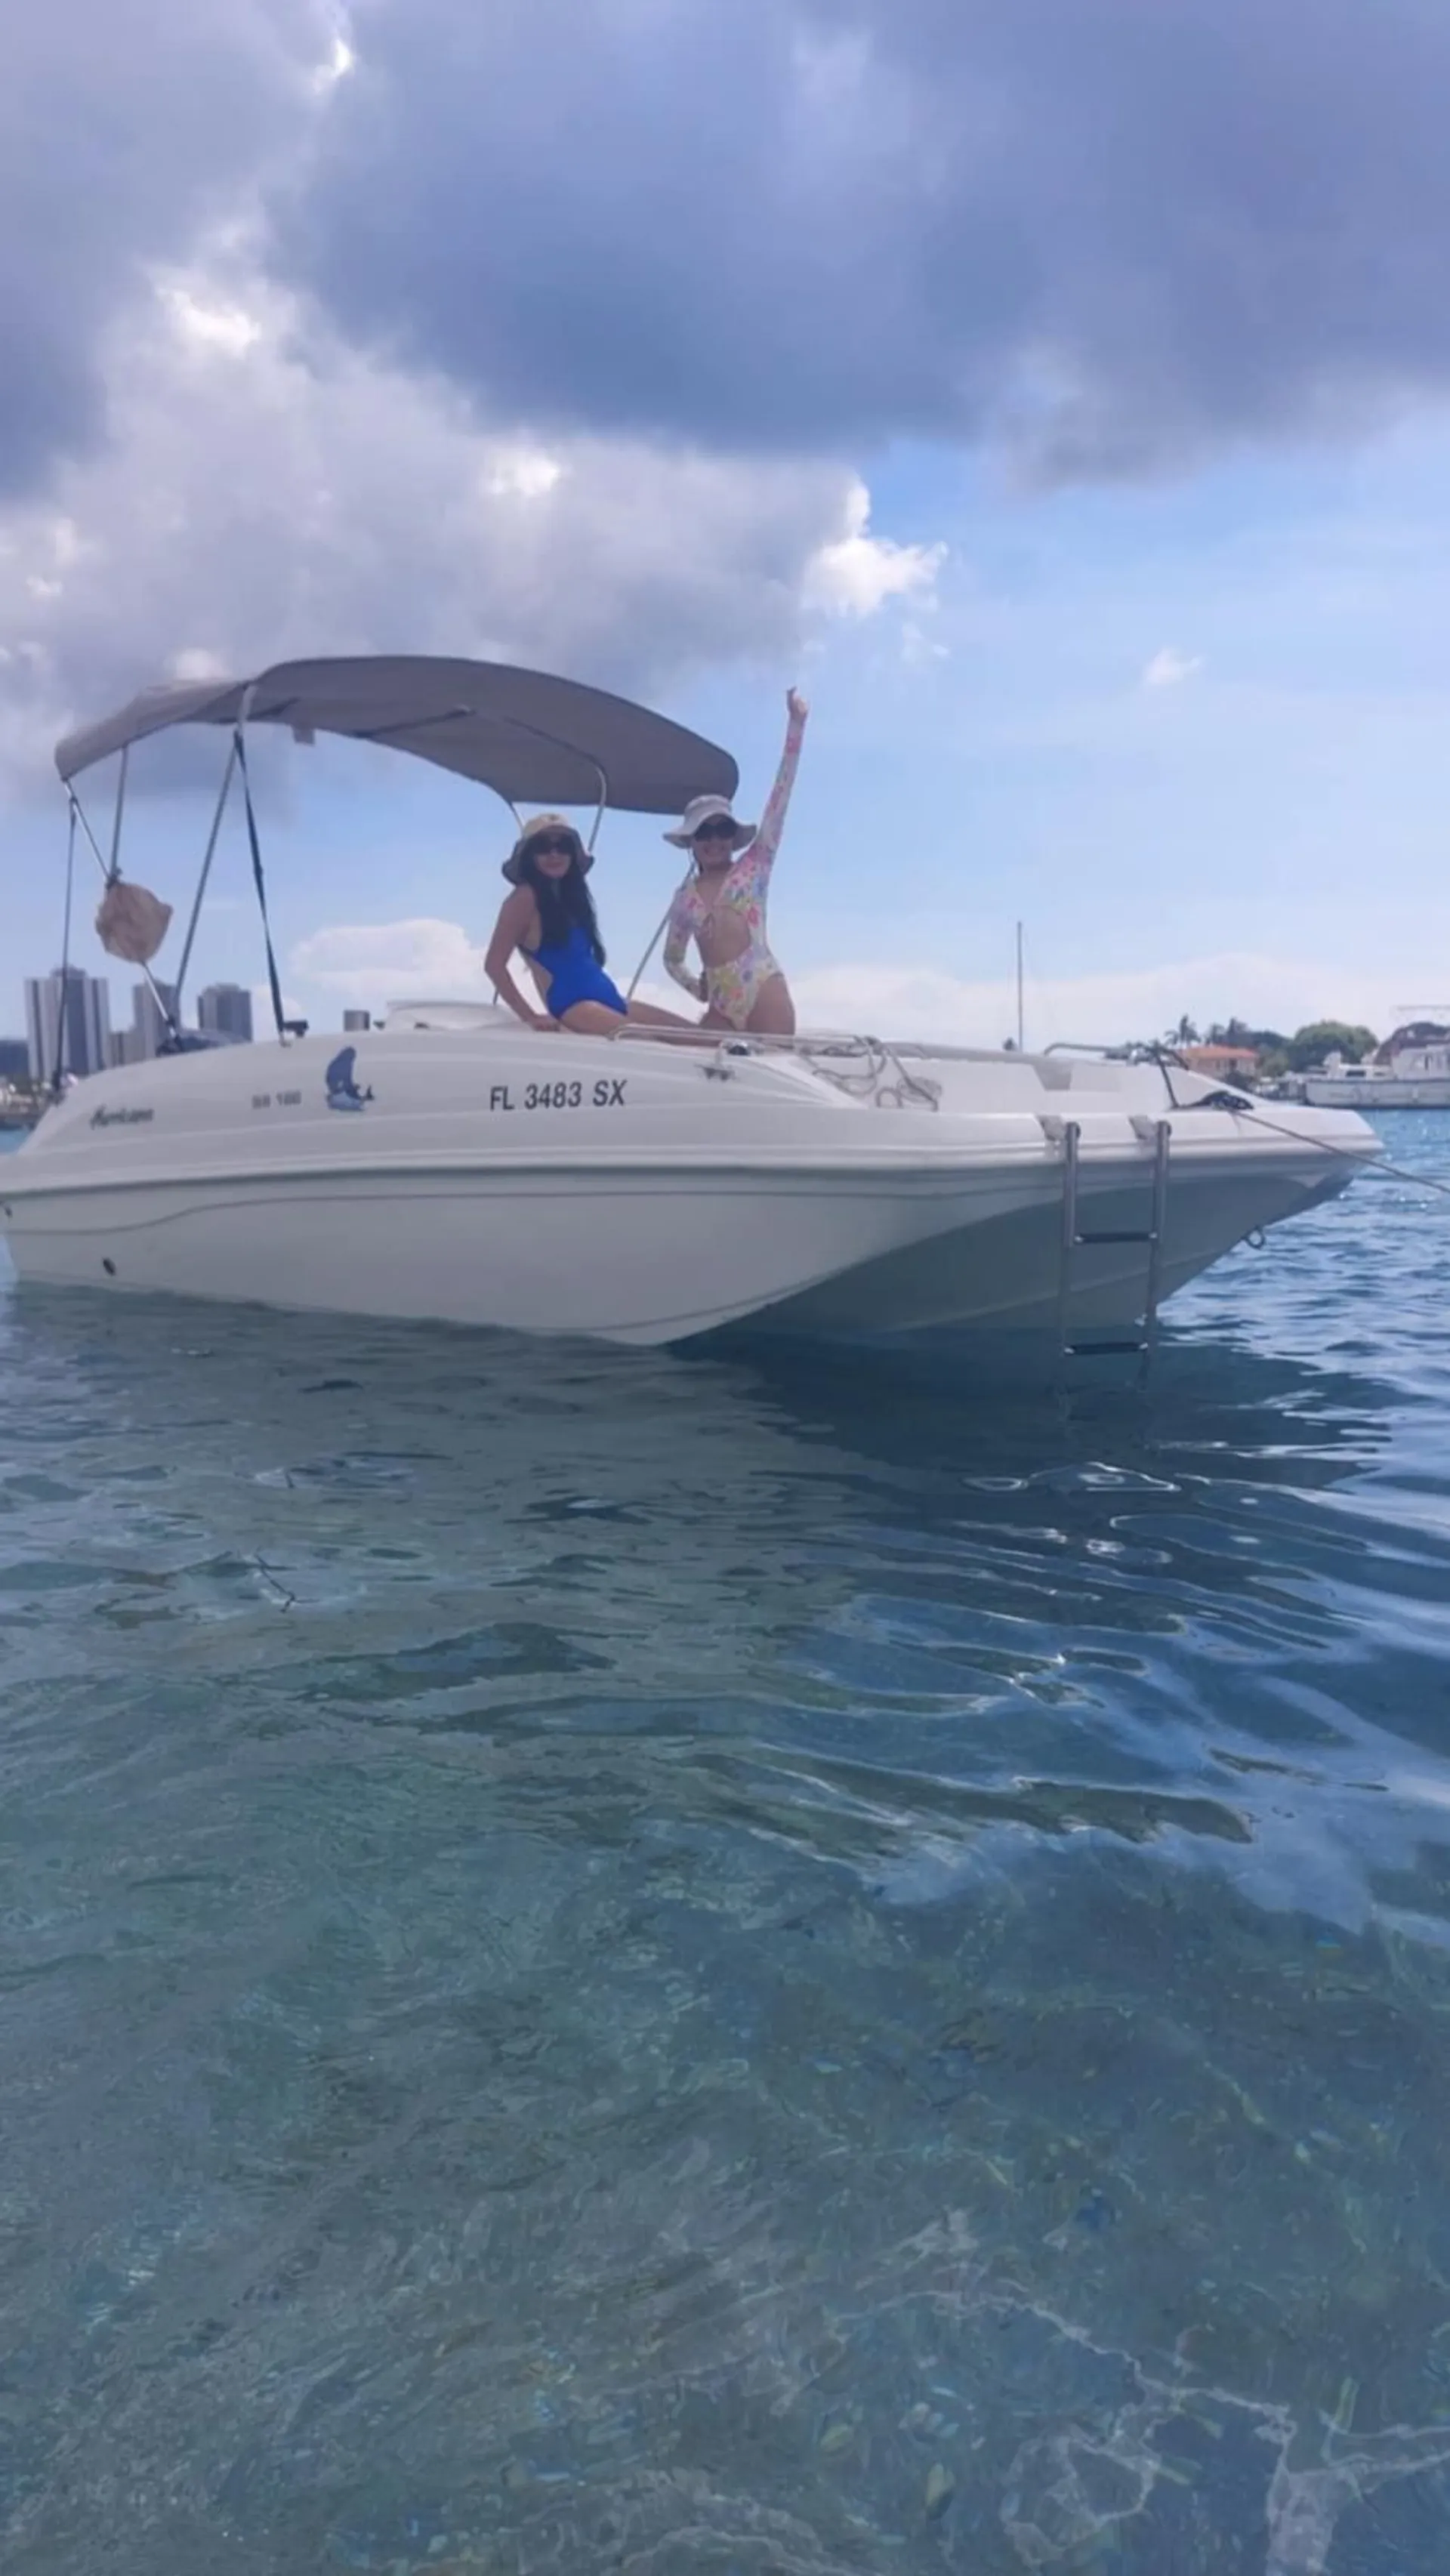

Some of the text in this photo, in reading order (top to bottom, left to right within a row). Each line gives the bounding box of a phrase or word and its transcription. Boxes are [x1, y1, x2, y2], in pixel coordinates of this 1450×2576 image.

[489, 1078, 628, 1112] FL 3483 SX
